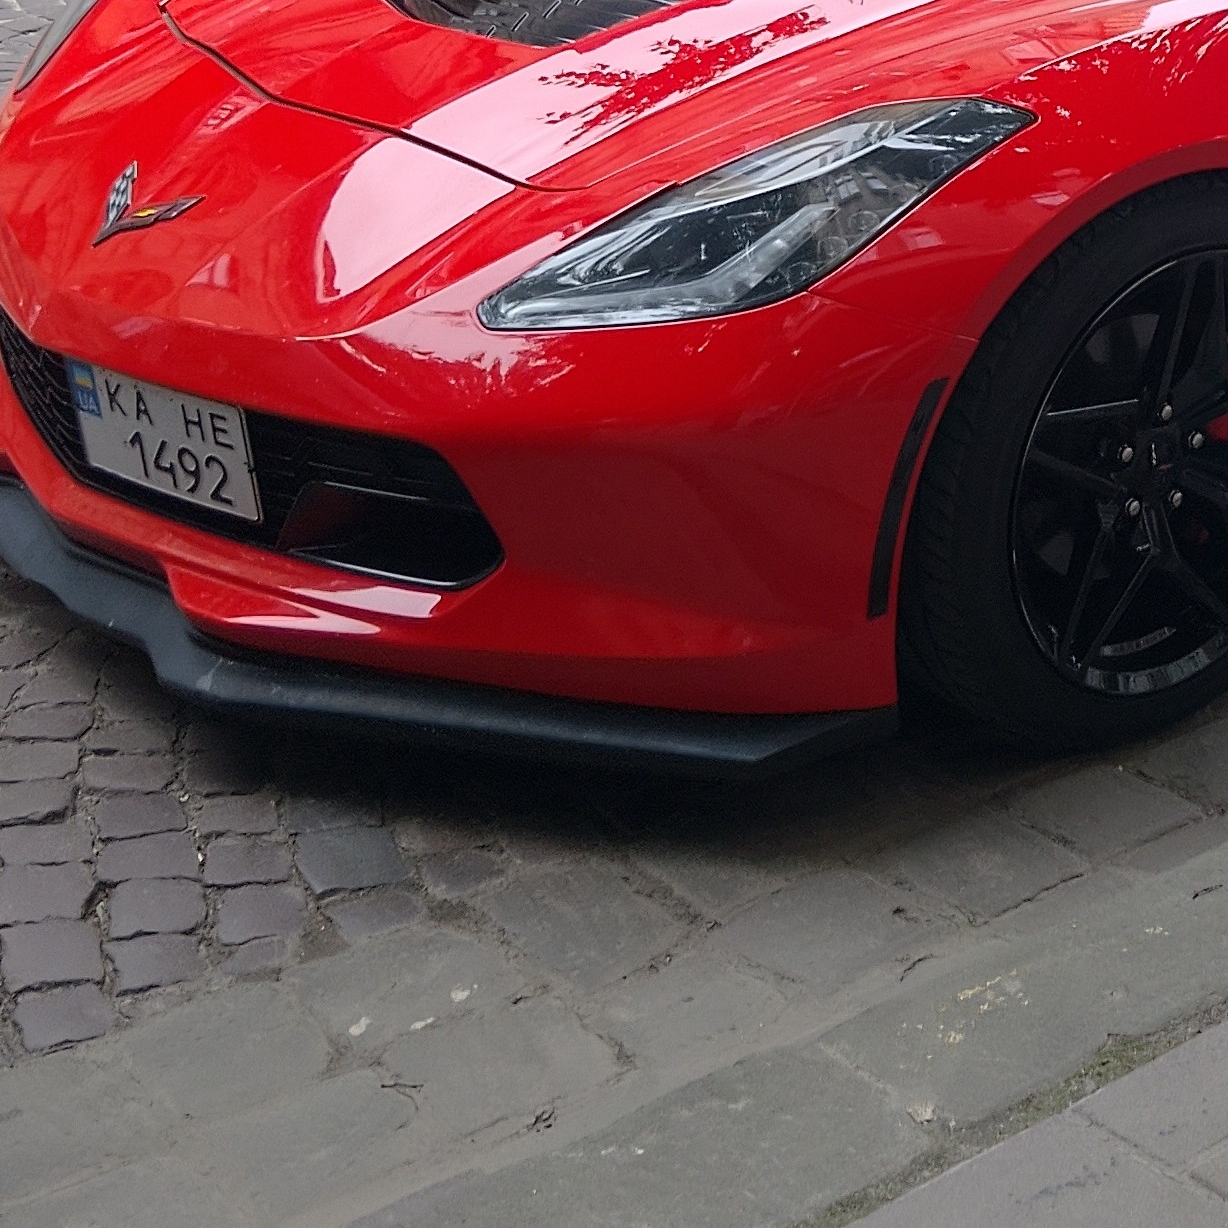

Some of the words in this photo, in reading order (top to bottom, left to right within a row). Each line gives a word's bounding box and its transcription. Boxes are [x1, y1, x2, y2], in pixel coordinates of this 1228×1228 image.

[76, 389, 99, 415] UA
[104, 378, 154, 427] KA
[180, 402, 234, 450] HE
[127, 430, 233, 506] 1492
